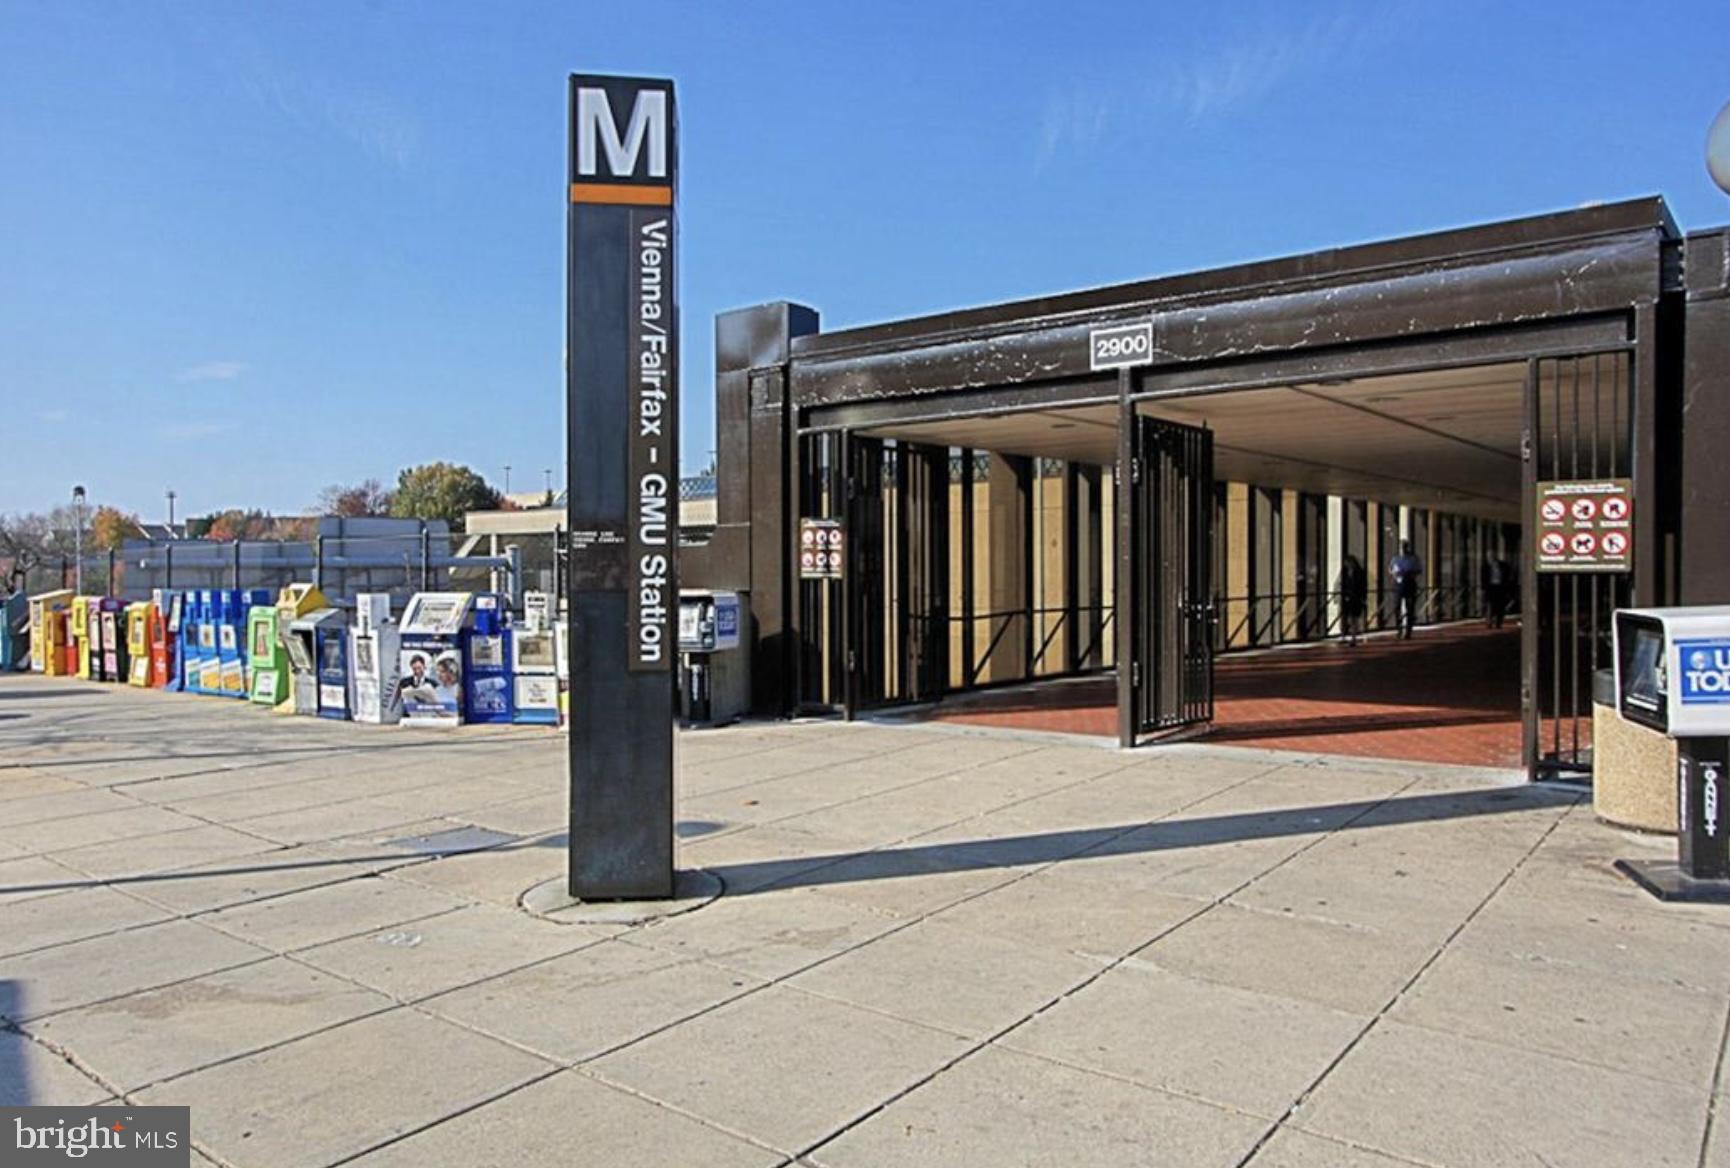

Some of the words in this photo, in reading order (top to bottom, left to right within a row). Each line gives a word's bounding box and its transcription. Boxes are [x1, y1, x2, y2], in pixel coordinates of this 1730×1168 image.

[577, 87, 667, 178] M
[640, 219, 667, 436] Vienna/Fairfax
[1096, 334, 1148, 359] 2900
[640, 474, 667, 545] GMU
[640, 554, 667, 662] Station
